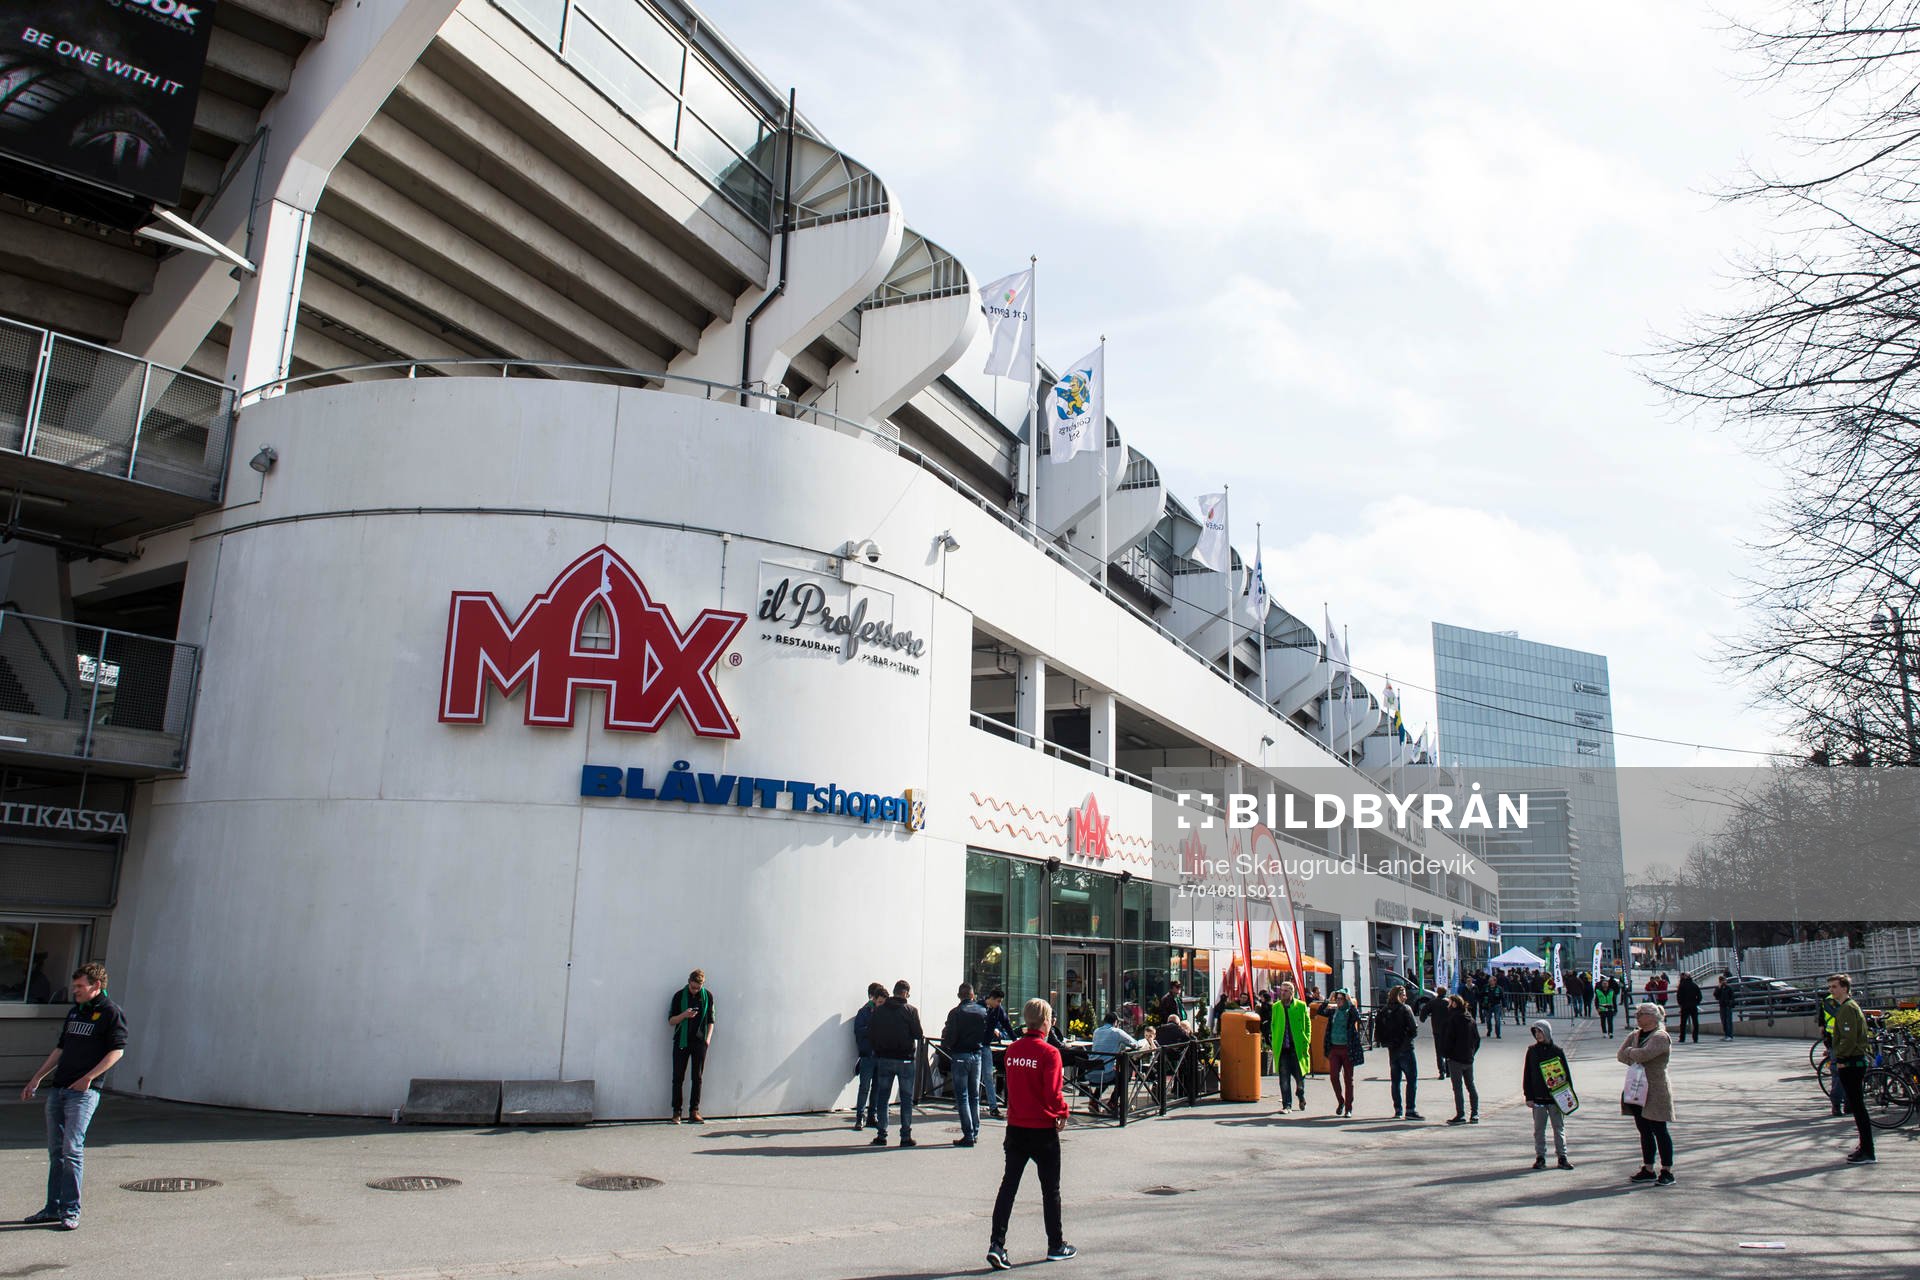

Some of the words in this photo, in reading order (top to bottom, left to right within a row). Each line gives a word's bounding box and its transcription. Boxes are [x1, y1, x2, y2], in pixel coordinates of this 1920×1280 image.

[21, 27, 54, 48] BE
[55, 40, 103, 67] ONE
[105, 57, 160, 88] WITH
[161, 79, 185, 96] IT
[438, 543, 748, 739] MAX
[758, 578, 790, 622] il
[789, 582, 926, 660] Professore
[775, 634, 841, 654] RESTAURANG
[873, 655, 889, 666] BAR
[1075, 792, 1110, 860] MAX
[1012, 1058, 1038, 1069] MORE
